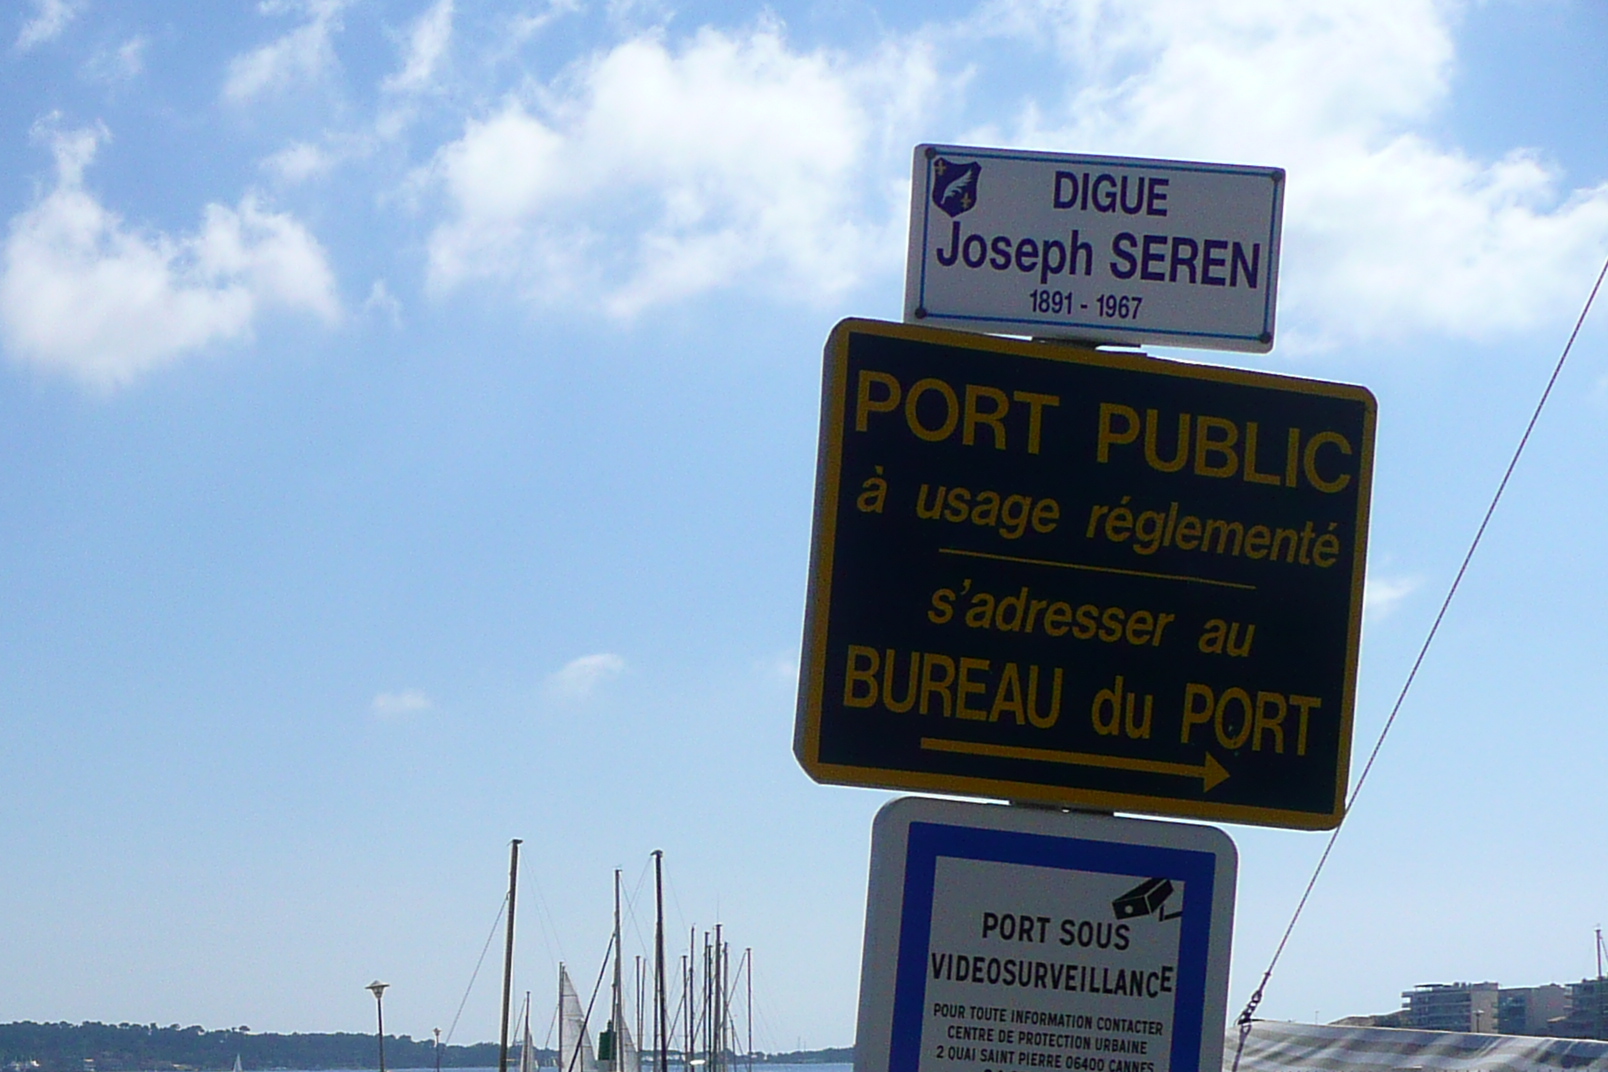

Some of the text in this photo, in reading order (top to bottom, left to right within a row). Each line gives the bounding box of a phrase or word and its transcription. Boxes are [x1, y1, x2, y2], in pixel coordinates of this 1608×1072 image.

[1053, 170, 1169, 217] DIGUE
[935, 221, 1261, 289] Joseph SEREN
[1029, 289, 1073, 315] 1891
[1096, 294, 1143, 320] 1967
[854, 369, 1353, 494] PORT PUBLIC
[856, 466, 1341, 568] à usage réglementé
[1197, 618, 1257, 658] au
[843, 644, 1322, 757] BUREAU du PORT
[982, 911, 1131, 951] PORT SOUS
[931, 952, 1174, 999] VIDEOSURVEILLANCE
[933, 1003, 1164, 1036] POUR TOUTE INFORMATION CONTACTER
[947, 1025, 1148, 1055] CENTRE DE PROTECTION URBAINE
[936, 1045, 944, 1059] 2
[948, 1046, 976, 1061] QUAI
[980, 1048, 1015, 1064] SAINT
[1018, 1051, 1062, 1069] PIERRE
[1065, 1055, 1105, 1072] 06400
